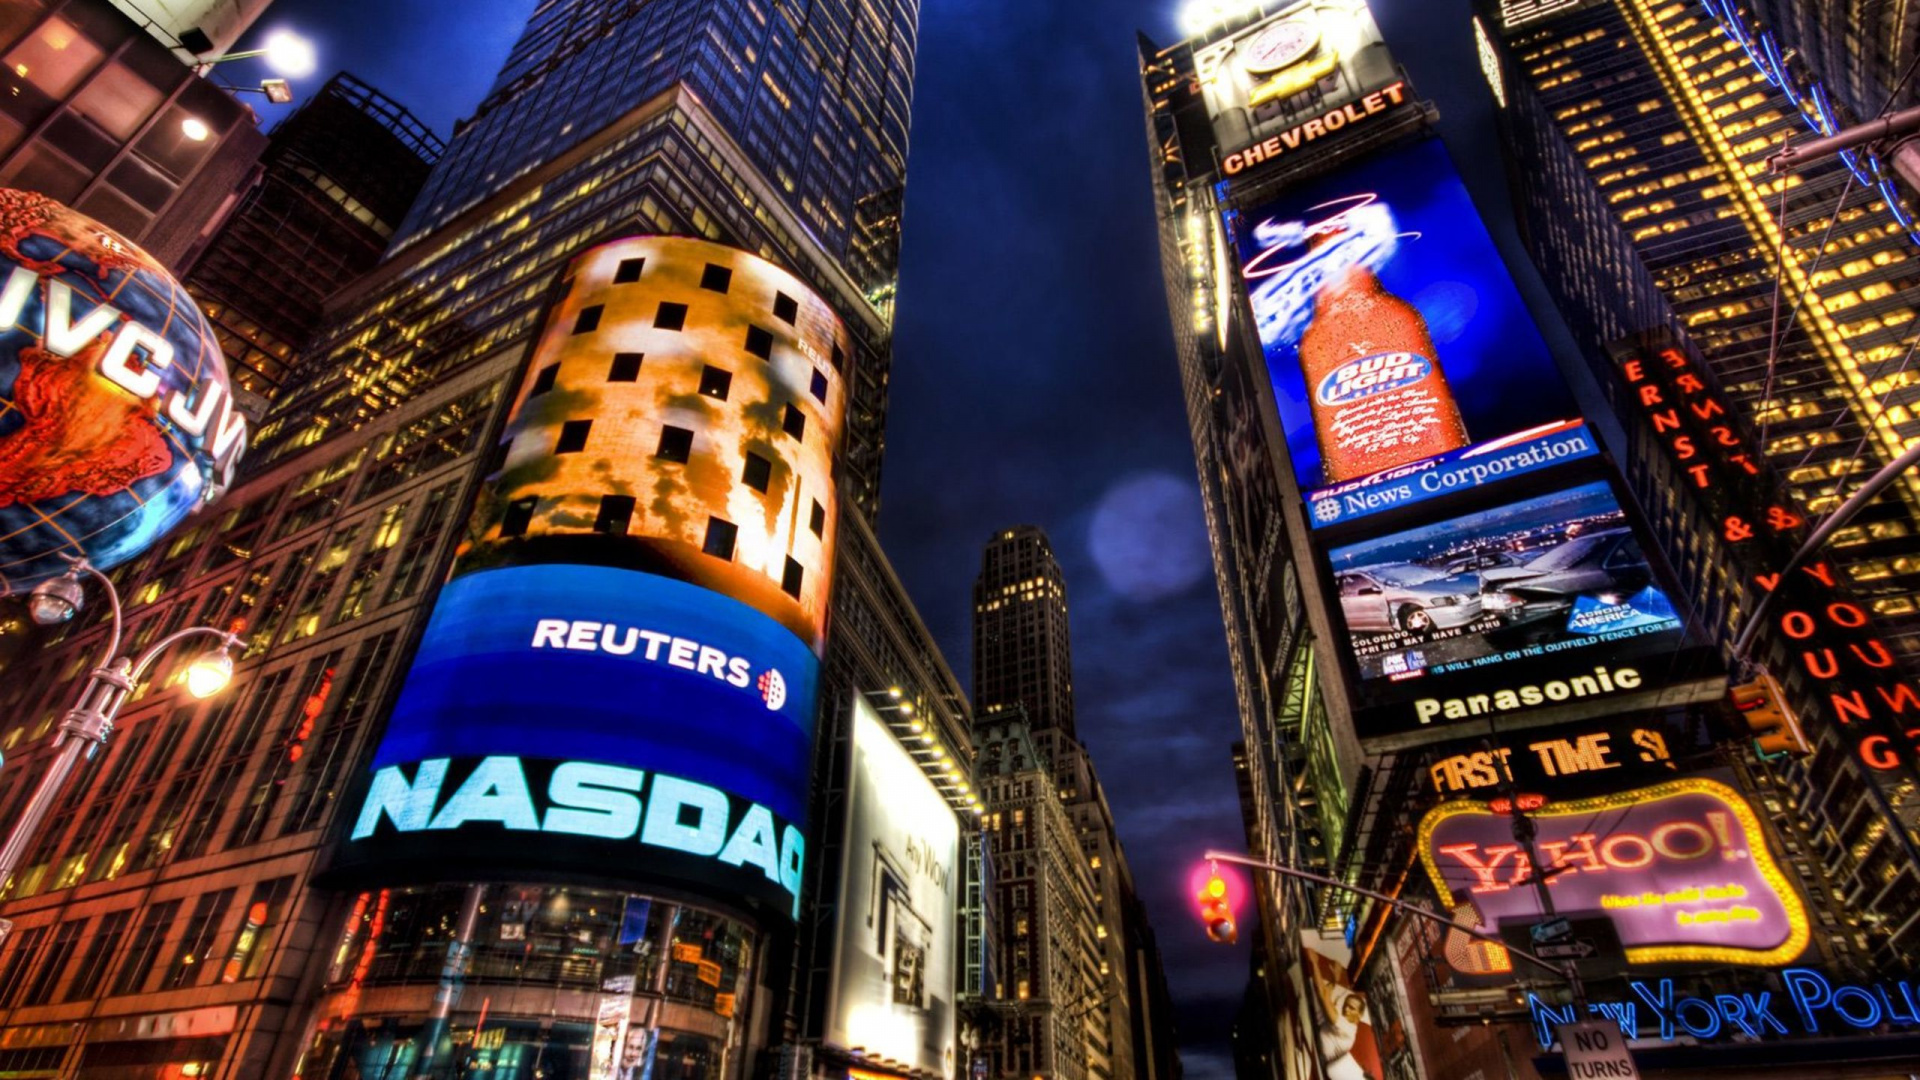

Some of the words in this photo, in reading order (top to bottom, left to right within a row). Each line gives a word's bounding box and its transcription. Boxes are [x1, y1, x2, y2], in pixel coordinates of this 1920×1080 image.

[1222, 82, 1404, 175] CHEVROLET
[1327, 363, 1425, 401] LIGHT
[1336, 352, 1412, 384] BUD
[1345, 484, 1412, 514] News
[1420, 436, 1588, 493] Corporation
[1623, 360, 1710, 488] ERNST
[1723, 515, 1754, 542] &
[1755, 573, 1900, 769] YOUNG
[1403, 635, 1424, 646] MAY
[1432, 628, 1462, 640] HAVE
[1446, 661, 1471, 672] WILL
[1473, 653, 1503, 667] HANG
[1504, 651, 1521, 661] ON
[1523, 646, 1544, 656] THE
[1545, 635, 1598, 653] OUTFIELD
[1599, 628, 1638, 643] FENCE
[1638, 622, 1664, 636] FOR
[1568, 608, 1642, 630] AMERICA
[531, 619, 751, 689] REUTERS
[1414, 666, 1642, 724] Panasonic
[1430, 747, 1513, 796] FIRST
[1529, 733, 1621, 777] TIME
[350, 756, 805, 922] NASDAQ
[1440, 812, 1736, 893] YAHOO!
[1631, 978, 1788, 1041] YORK
[1782, 968, 1920, 1034] POLI
[1571, 1059, 1633, 1079] TURNS
[1574, 1029, 1609, 1052] NO
